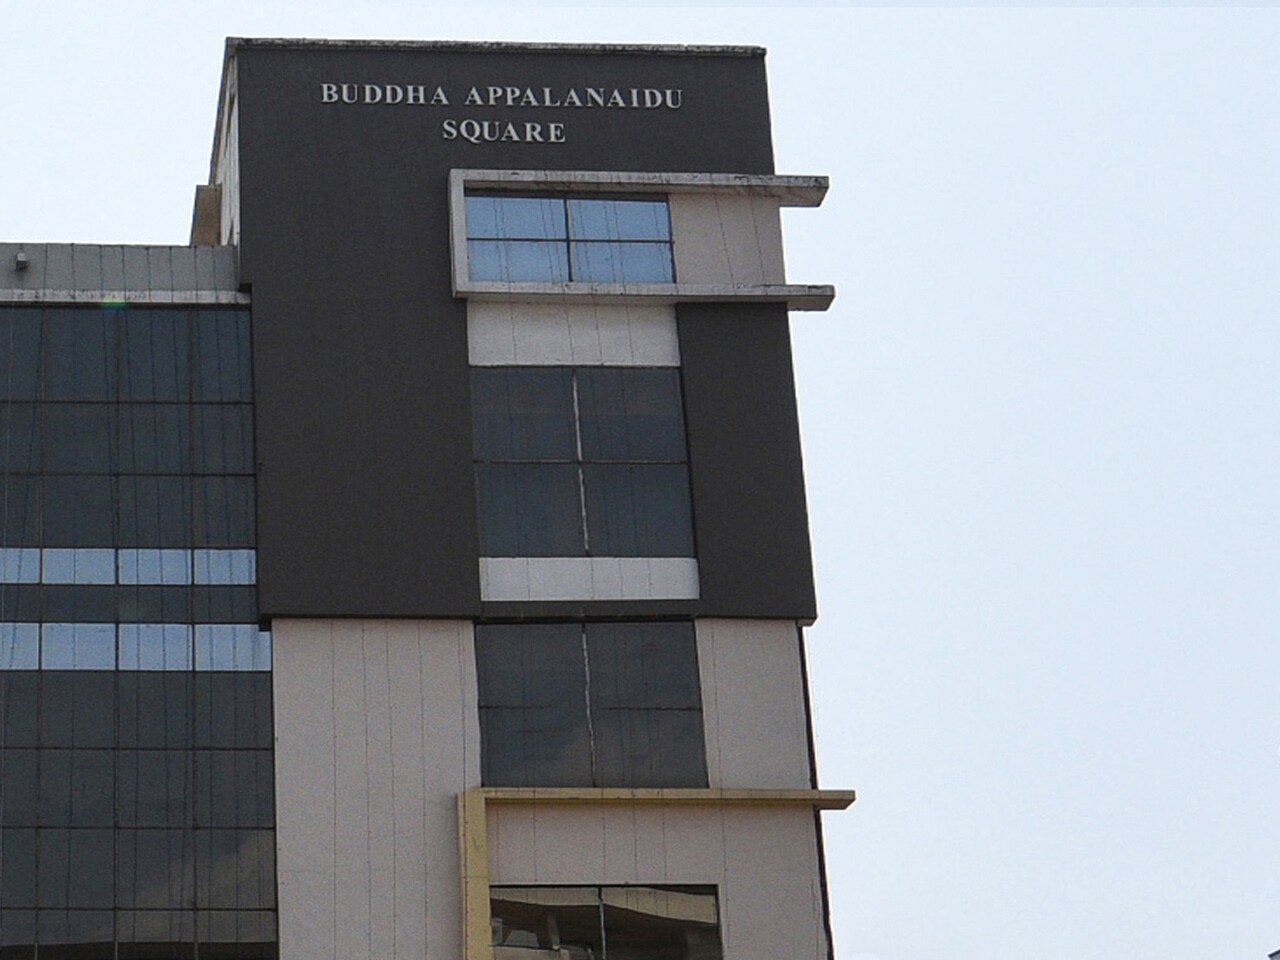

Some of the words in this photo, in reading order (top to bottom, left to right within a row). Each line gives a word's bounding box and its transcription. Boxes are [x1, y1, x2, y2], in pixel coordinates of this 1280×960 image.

[320, 83, 450, 106] BUDDHA
[464, 85, 684, 110] APPALANAIDU
[441, 118, 567, 144] SQUARE
